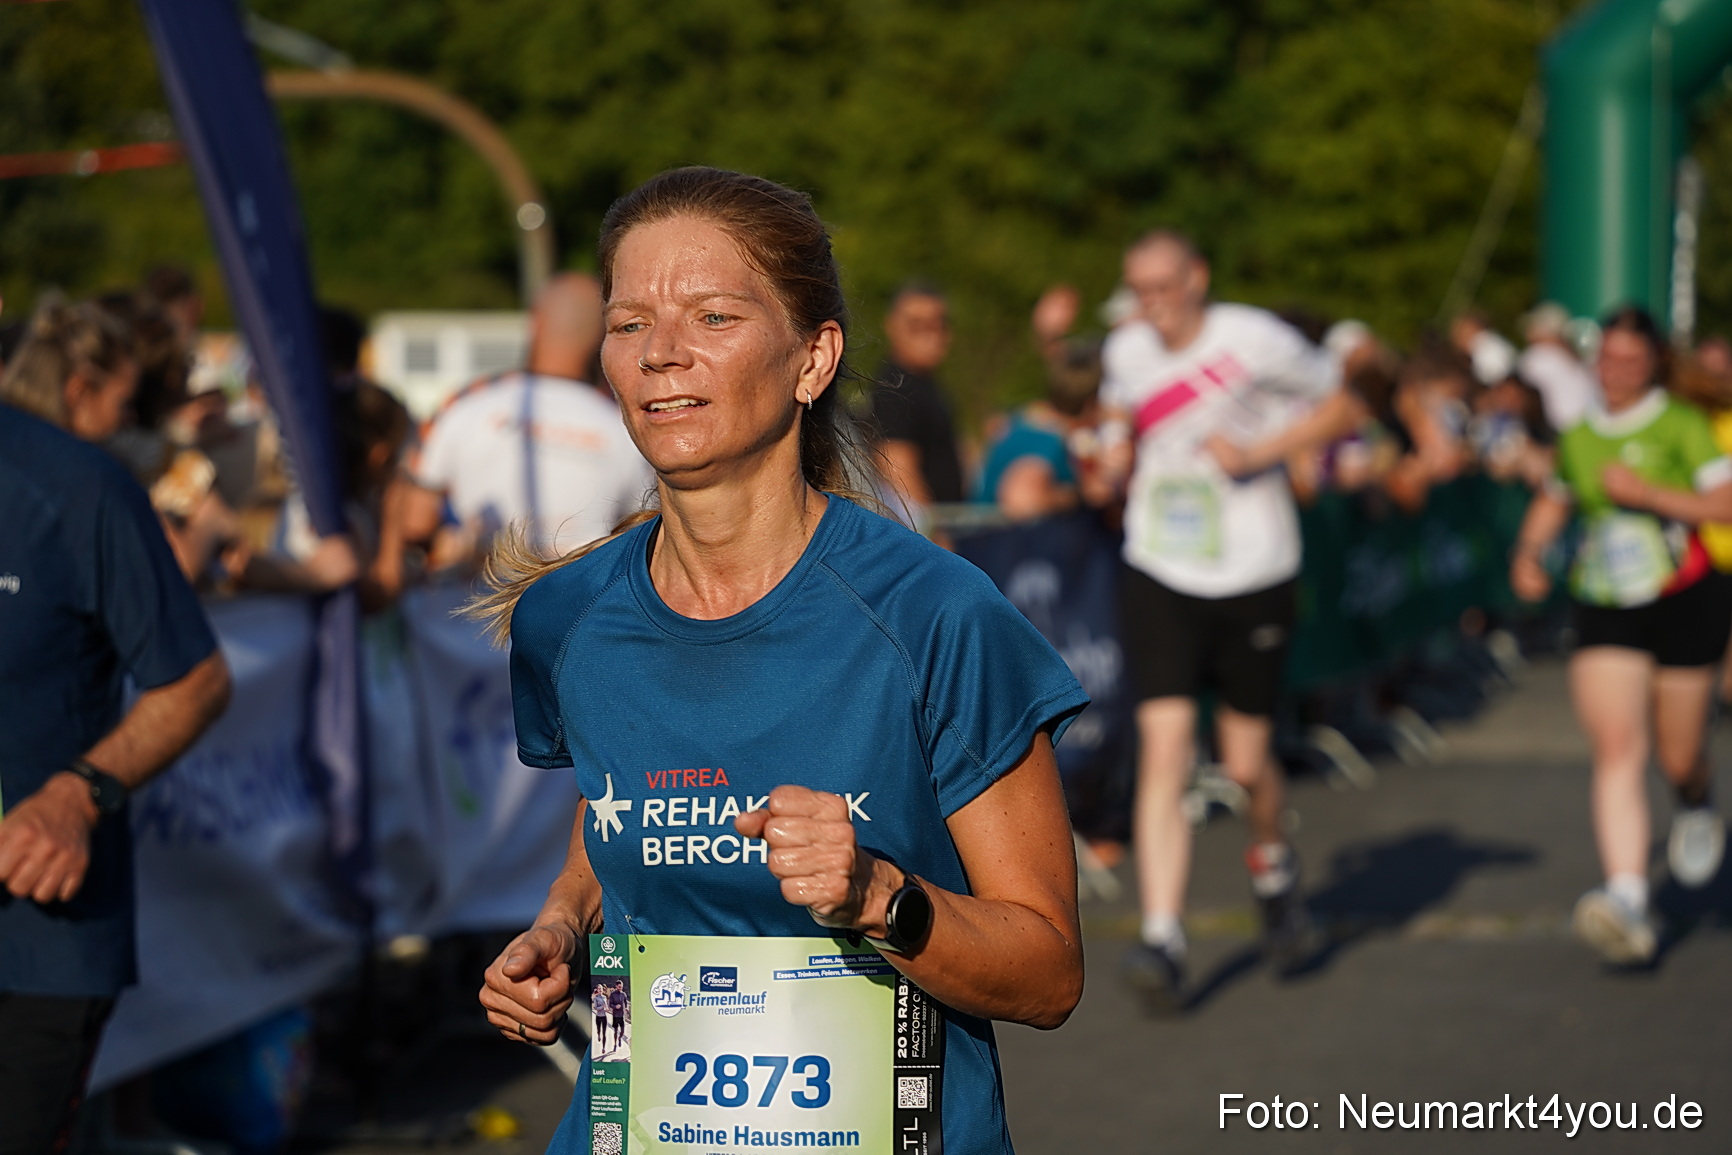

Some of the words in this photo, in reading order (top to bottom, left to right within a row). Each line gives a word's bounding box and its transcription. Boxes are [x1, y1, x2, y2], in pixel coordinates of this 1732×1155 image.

[645, 768, 729, 790] VITREA
[642, 791, 871, 830] REHAKK
[641, 833, 768, 867] BERCH
[594, 955, 624, 969] AOK
[858, 955, 882, 963] Walken
[707, 975, 736, 985] Fischer
[776, 972, 797, 980] Essen,
[688, 990, 767, 1007] Firmenlauf
[897, 974, 909, 1019] RABA
[717, 1004, 766, 1016] neumarkt
[897, 1021, 908, 1034] %
[911, 1004, 921, 1058] FACTORY
[897, 1036, 908, 1059] 20
[603, 1077, 626, 1085] Laufen?
[675, 1053, 832, 1109] 2873
[658, 1122, 728, 1146] Sabine
[734, 1124, 860, 1147] Hausmann
